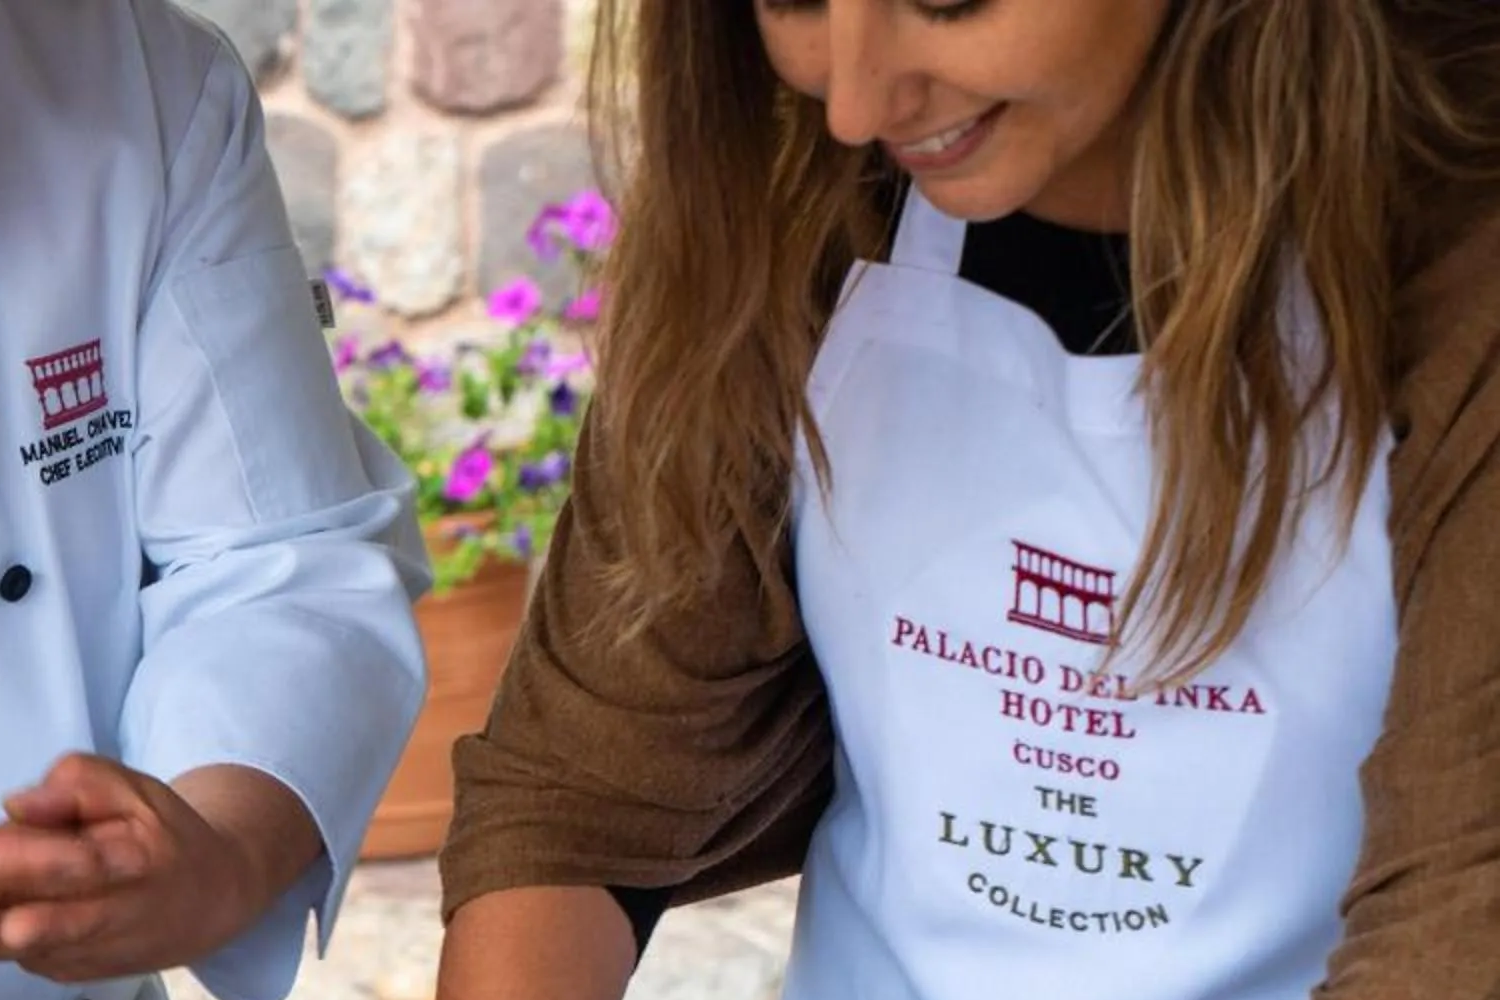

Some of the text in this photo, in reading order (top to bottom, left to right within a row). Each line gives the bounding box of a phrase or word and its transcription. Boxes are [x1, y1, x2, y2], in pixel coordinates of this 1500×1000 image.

[20, 427, 84, 465] MANUEL
[40, 458, 71, 485] CHEF
[891, 616, 1266, 714] PALACIO DEL INKA
[1000, 689, 1136, 739] HOTEL
[1012, 740, 1121, 781] CUSCO
[1034, 785, 1098, 817] THE
[938, 811, 1204, 887] LUXURY
[967, 872, 1171, 933] COLLECTION
